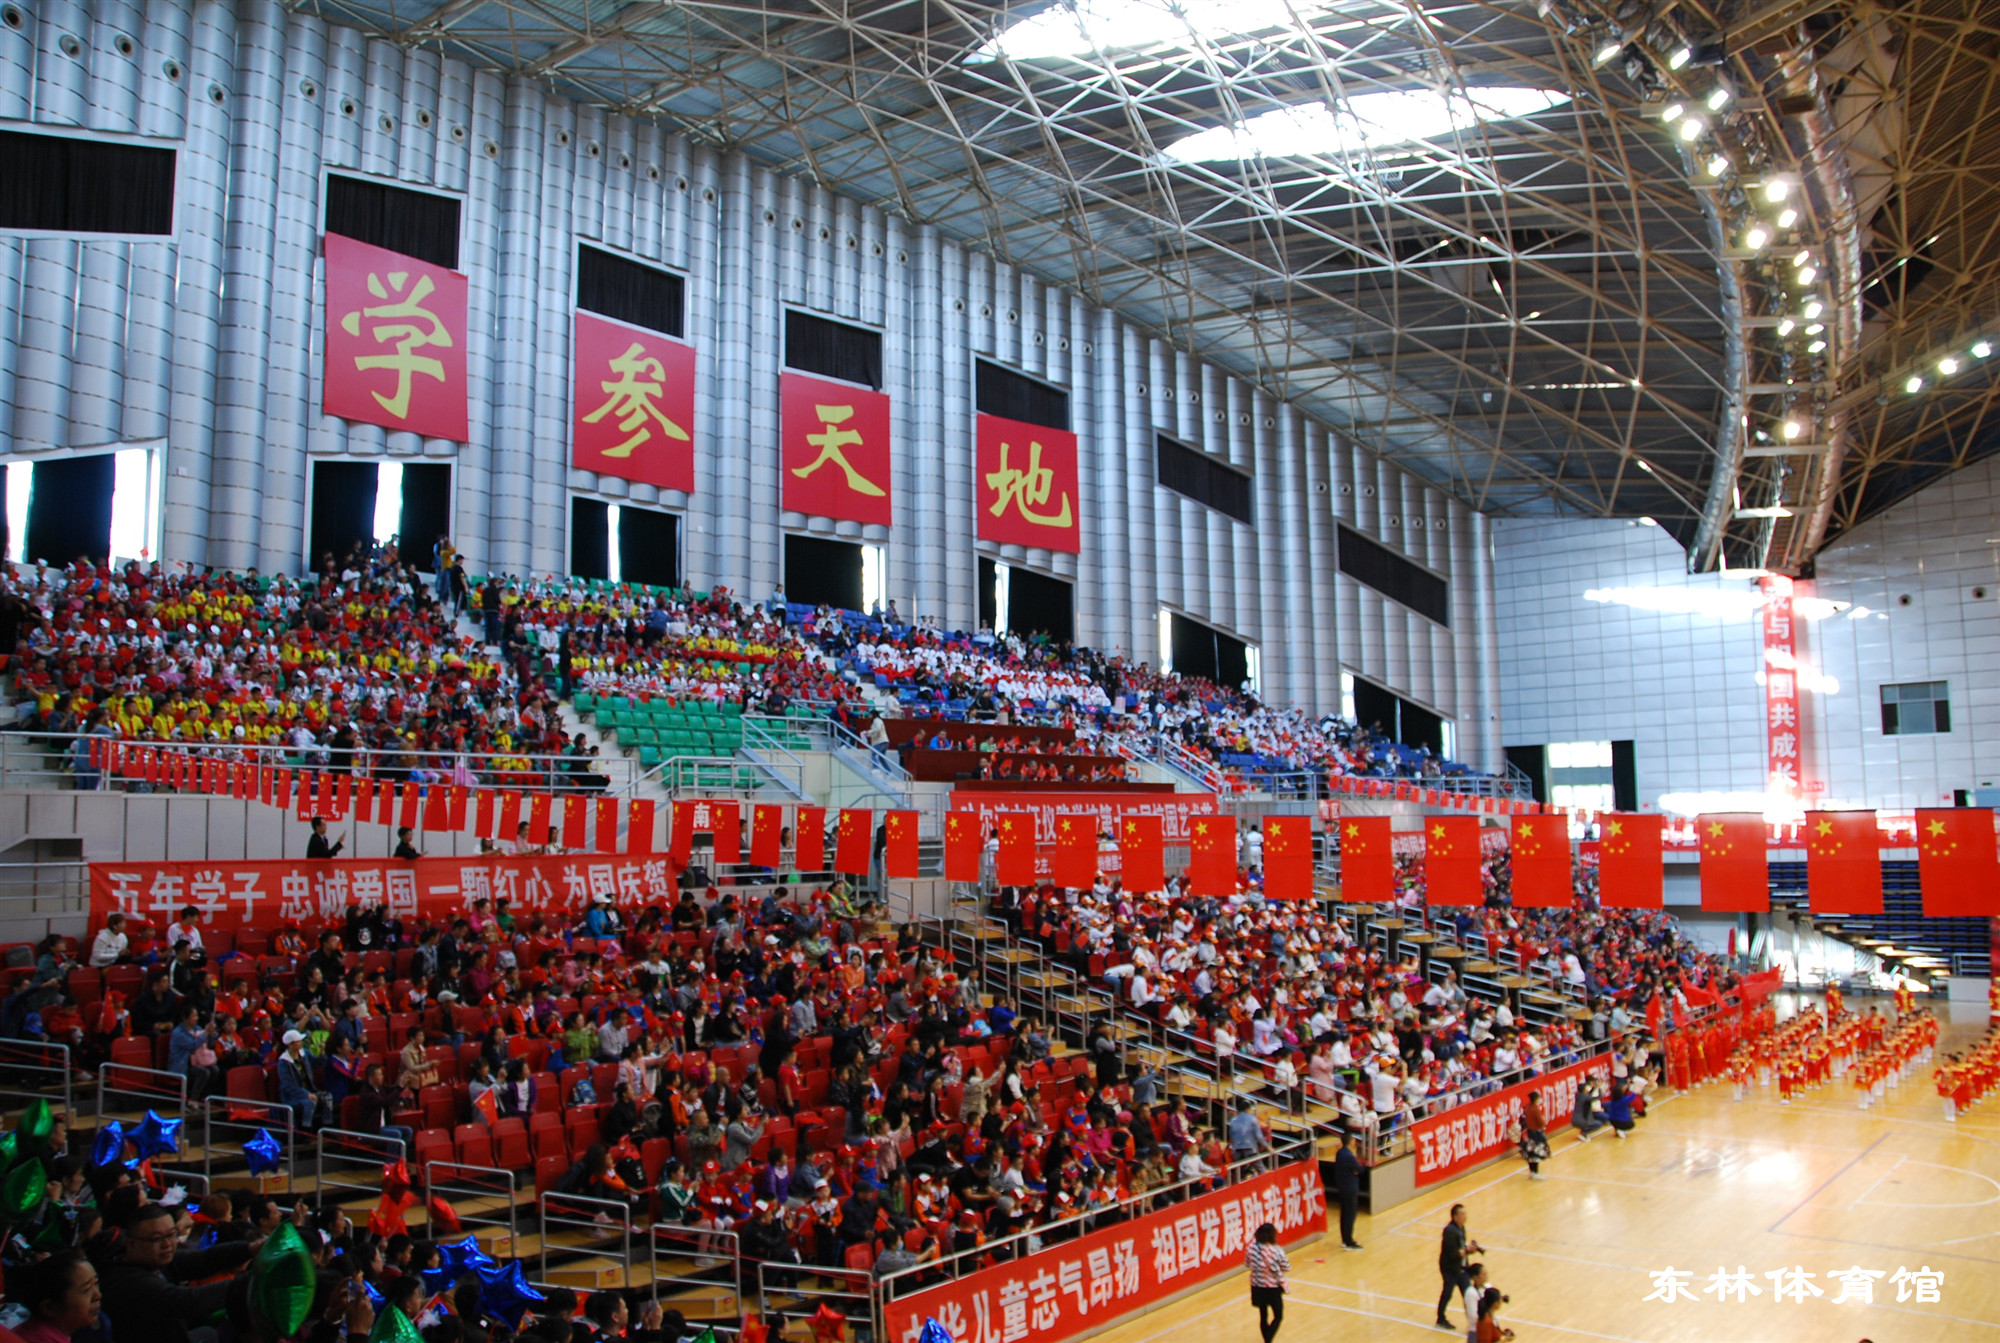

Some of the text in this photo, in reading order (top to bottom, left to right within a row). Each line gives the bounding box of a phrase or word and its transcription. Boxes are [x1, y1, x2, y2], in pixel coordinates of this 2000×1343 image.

[341, 271, 453, 419] 学
[582, 342, 690, 458] 参
[791, 405, 886, 497] 天
[986, 441, 1073, 528] 地
[108, 869, 267, 924] 五年学子
[429, 866, 553, 912] 一颗红心
[563, 860, 669, 909] 为国庆贺
[1152, 1170, 1325, 1284] 祖国发展助我成长
